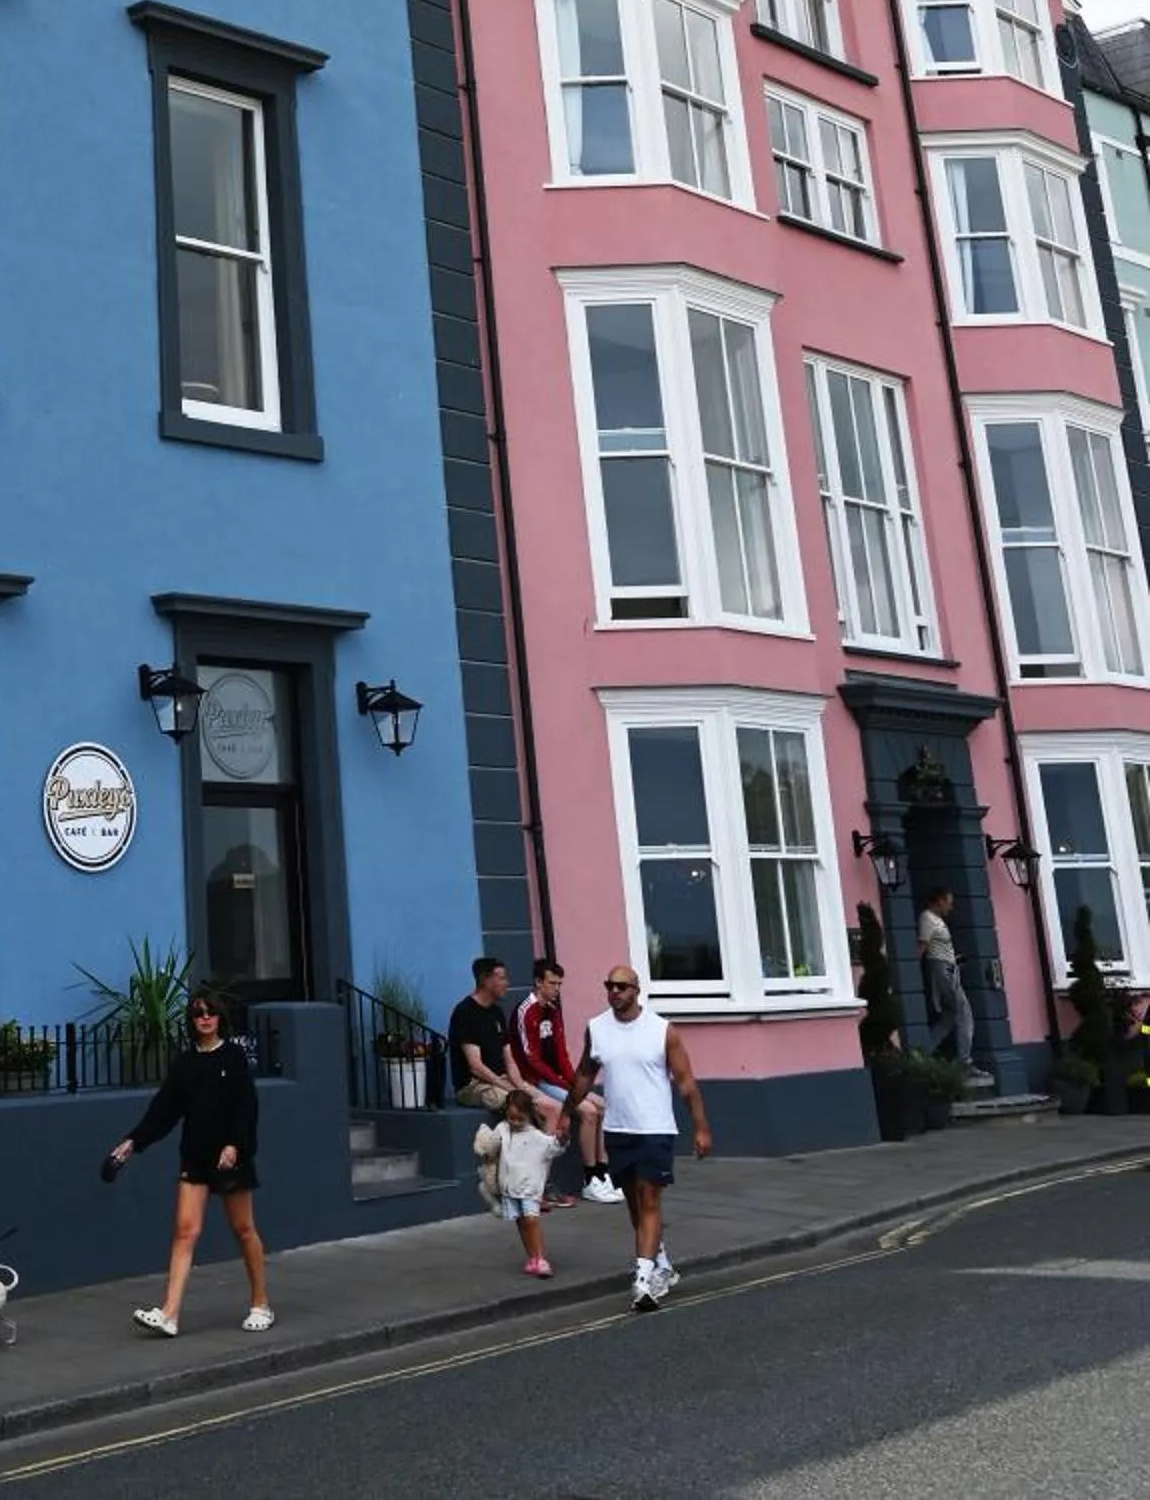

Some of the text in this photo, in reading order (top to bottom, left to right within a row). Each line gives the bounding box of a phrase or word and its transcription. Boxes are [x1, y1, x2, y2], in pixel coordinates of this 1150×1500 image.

[48, 775, 133, 821] Puxley's
[64, 826, 119, 837] CAFÉ BAR
